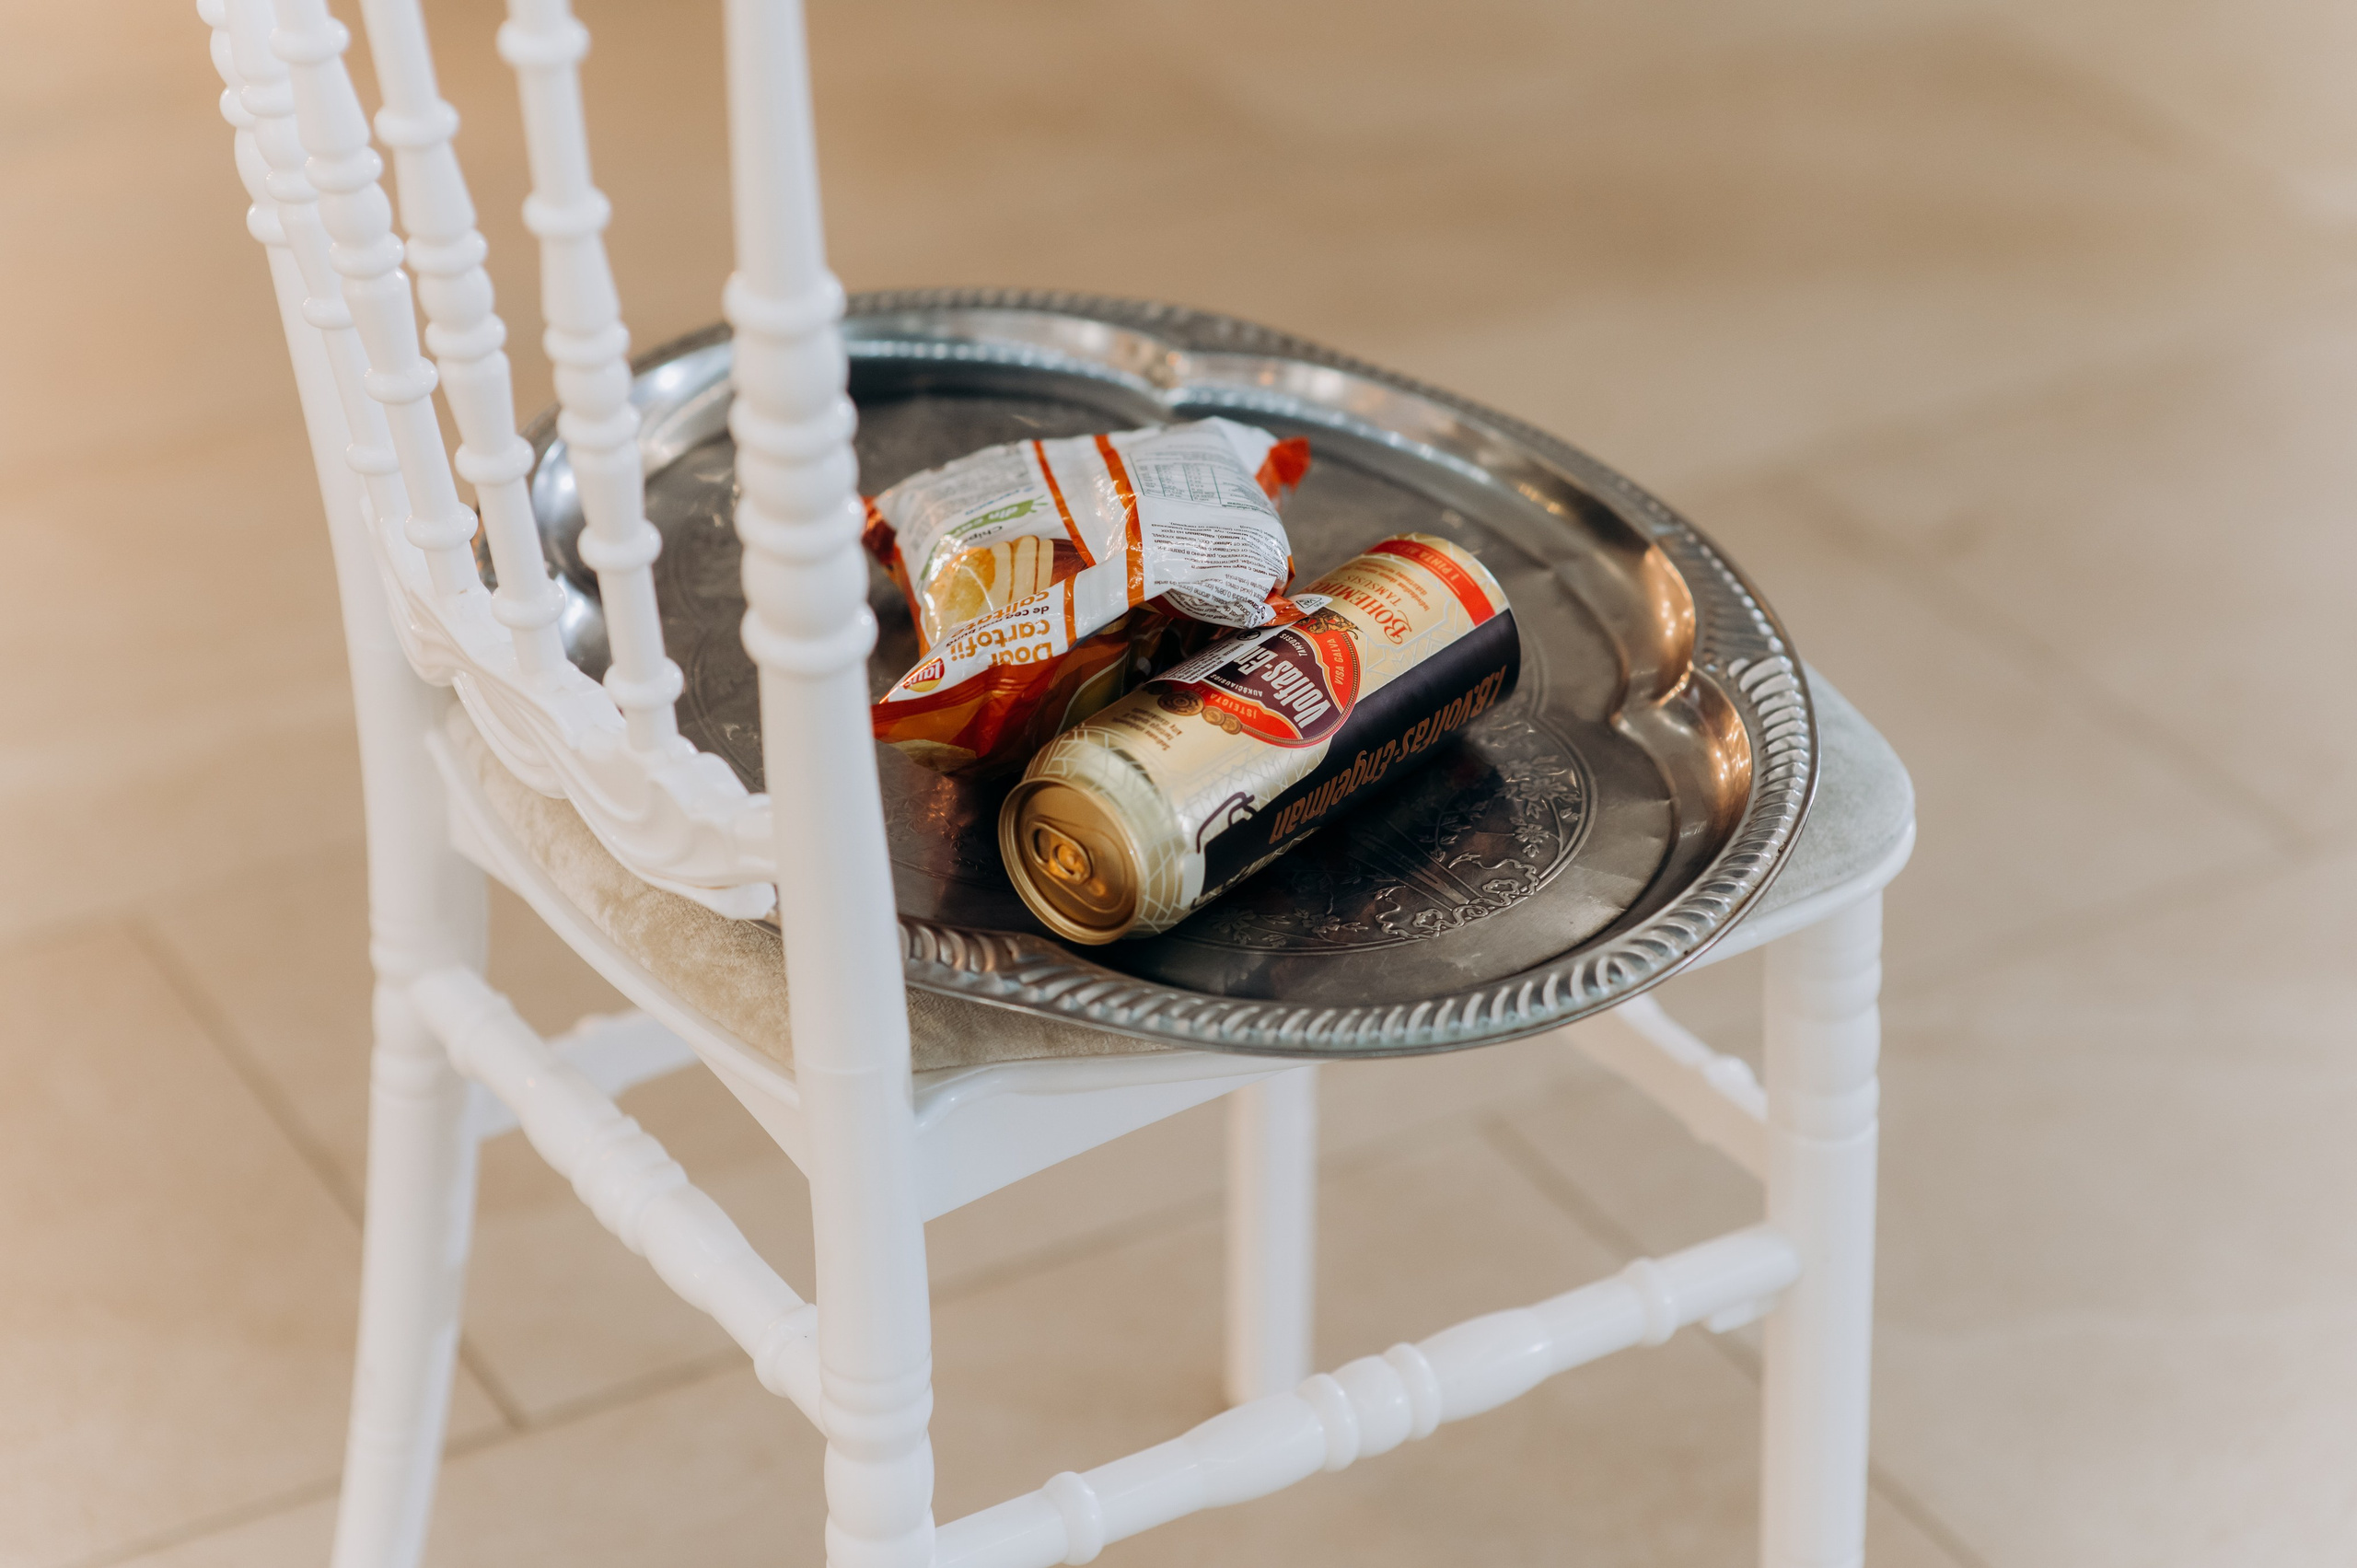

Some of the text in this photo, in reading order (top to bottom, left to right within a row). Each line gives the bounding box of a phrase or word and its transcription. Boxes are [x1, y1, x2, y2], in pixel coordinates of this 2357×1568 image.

[1420, 548, 1454, 575] PINTA
[1033, 605, 1050, 614] de
[1345, 575, 1402, 607] TAMSUSIS
[951, 590, 1049, 638] calitate
[1005, 610, 1029, 620] cea
[950, 619, 1050, 661] cartofii
[1327, 636, 1345, 687] VISA GALVA
[1235, 641, 1332, 729] Volfas-En
